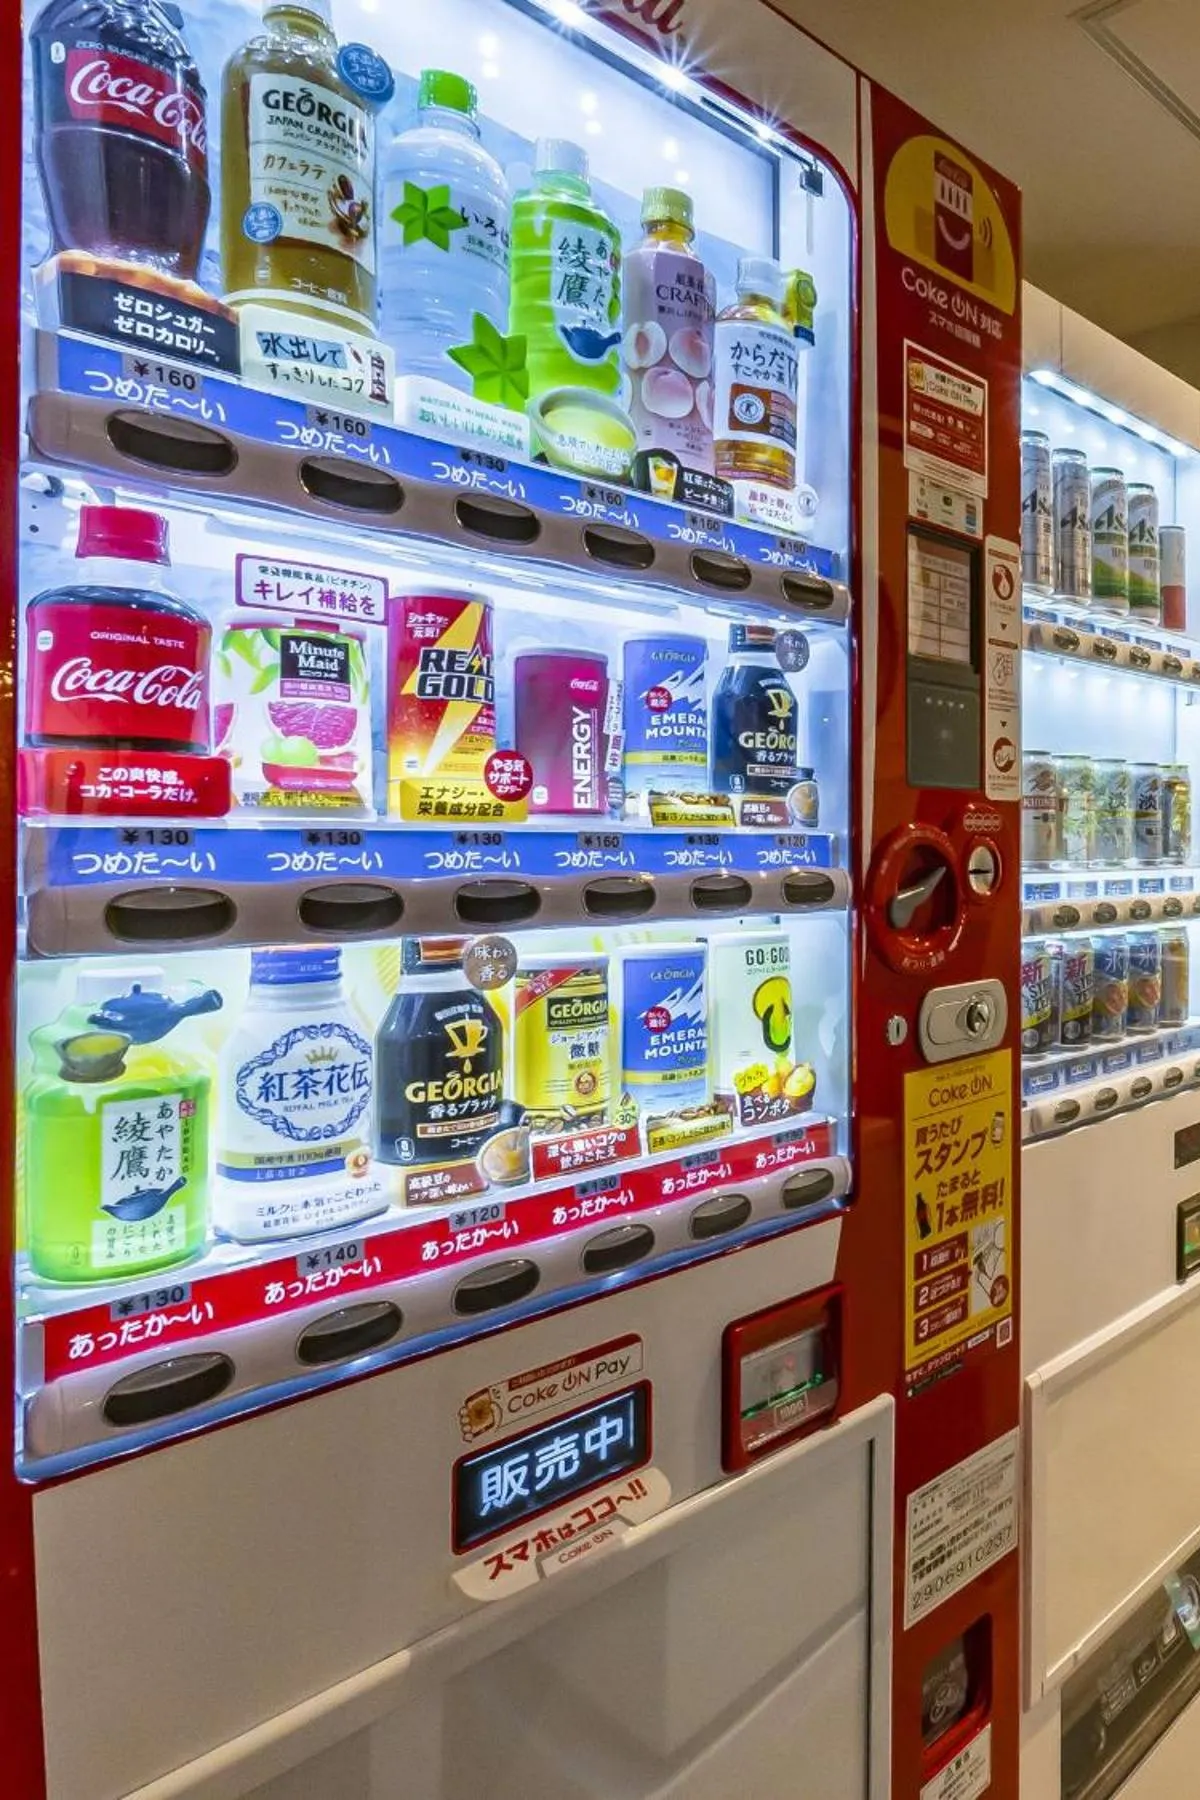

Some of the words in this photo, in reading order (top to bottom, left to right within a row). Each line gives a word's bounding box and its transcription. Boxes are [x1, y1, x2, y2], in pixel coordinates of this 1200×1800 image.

[70, 60, 206, 154] Coca-Cola
[267, 114, 304, 131] JAPAN
[263, 153, 326, 180] カフェラテ
[558, 236, 592, 310] 綾鷹
[902, 267, 948, 310] Coke
[113, 291, 216, 334] ゼロシュガー
[262, 332, 339, 366] 水出して
[730, 342, 785, 369] からだ
[133, 361, 196, 391] ¥160
[316, 411, 366, 437] ¥160
[254, 579, 375, 616] キレイ補給を
[90, 631, 151, 645] ORIGINAL
[153, 636, 185, 649] TASTE
[289, 640, 345, 660] Minute
[298, 655, 339, 671] Maid
[51, 657, 204, 711] Coca-Cola
[571, 706, 593, 809] ENERGY
[97, 767, 185, 786] この爽快感。
[488, 771, 530, 785] サポート
[417, 801, 506, 818] 栄養成分配合
[122, 830, 190, 846] ¥130
[307, 831, 361, 846] ¥130
[457, 833, 502, 847] ¥130
[584, 836, 620, 849] ¥160
[479, 964, 508, 982] 香る
[257, 1062, 370, 1103] 紅茶花伝
[929, 1083, 967, 1108] Coke
[970, 1075, 993, 1095] ON
[743, 1099, 791, 1122] コンポタ
[110, 1112, 154, 1181] 綾鷹
[155, 1101, 175, 1183] あやたか
[450, 1136, 482, 1149] コーヒー
[915, 1127, 988, 1181] スタンプ
[454, 1206, 500, 1229] ¥120
[307, 1244, 358, 1269] ¥140
[118, 1287, 184, 1316] ¥130
[918, 1286, 929, 1306] 2
[918, 1318, 929, 1338] 3
[507, 1383, 560, 1414] Coke
[562, 1368, 592, 1392] ON
[595, 1355, 631, 1380] Pay
[480, 1414, 624, 1517] 販売中
[558, 1540, 592, 1566] Coke
